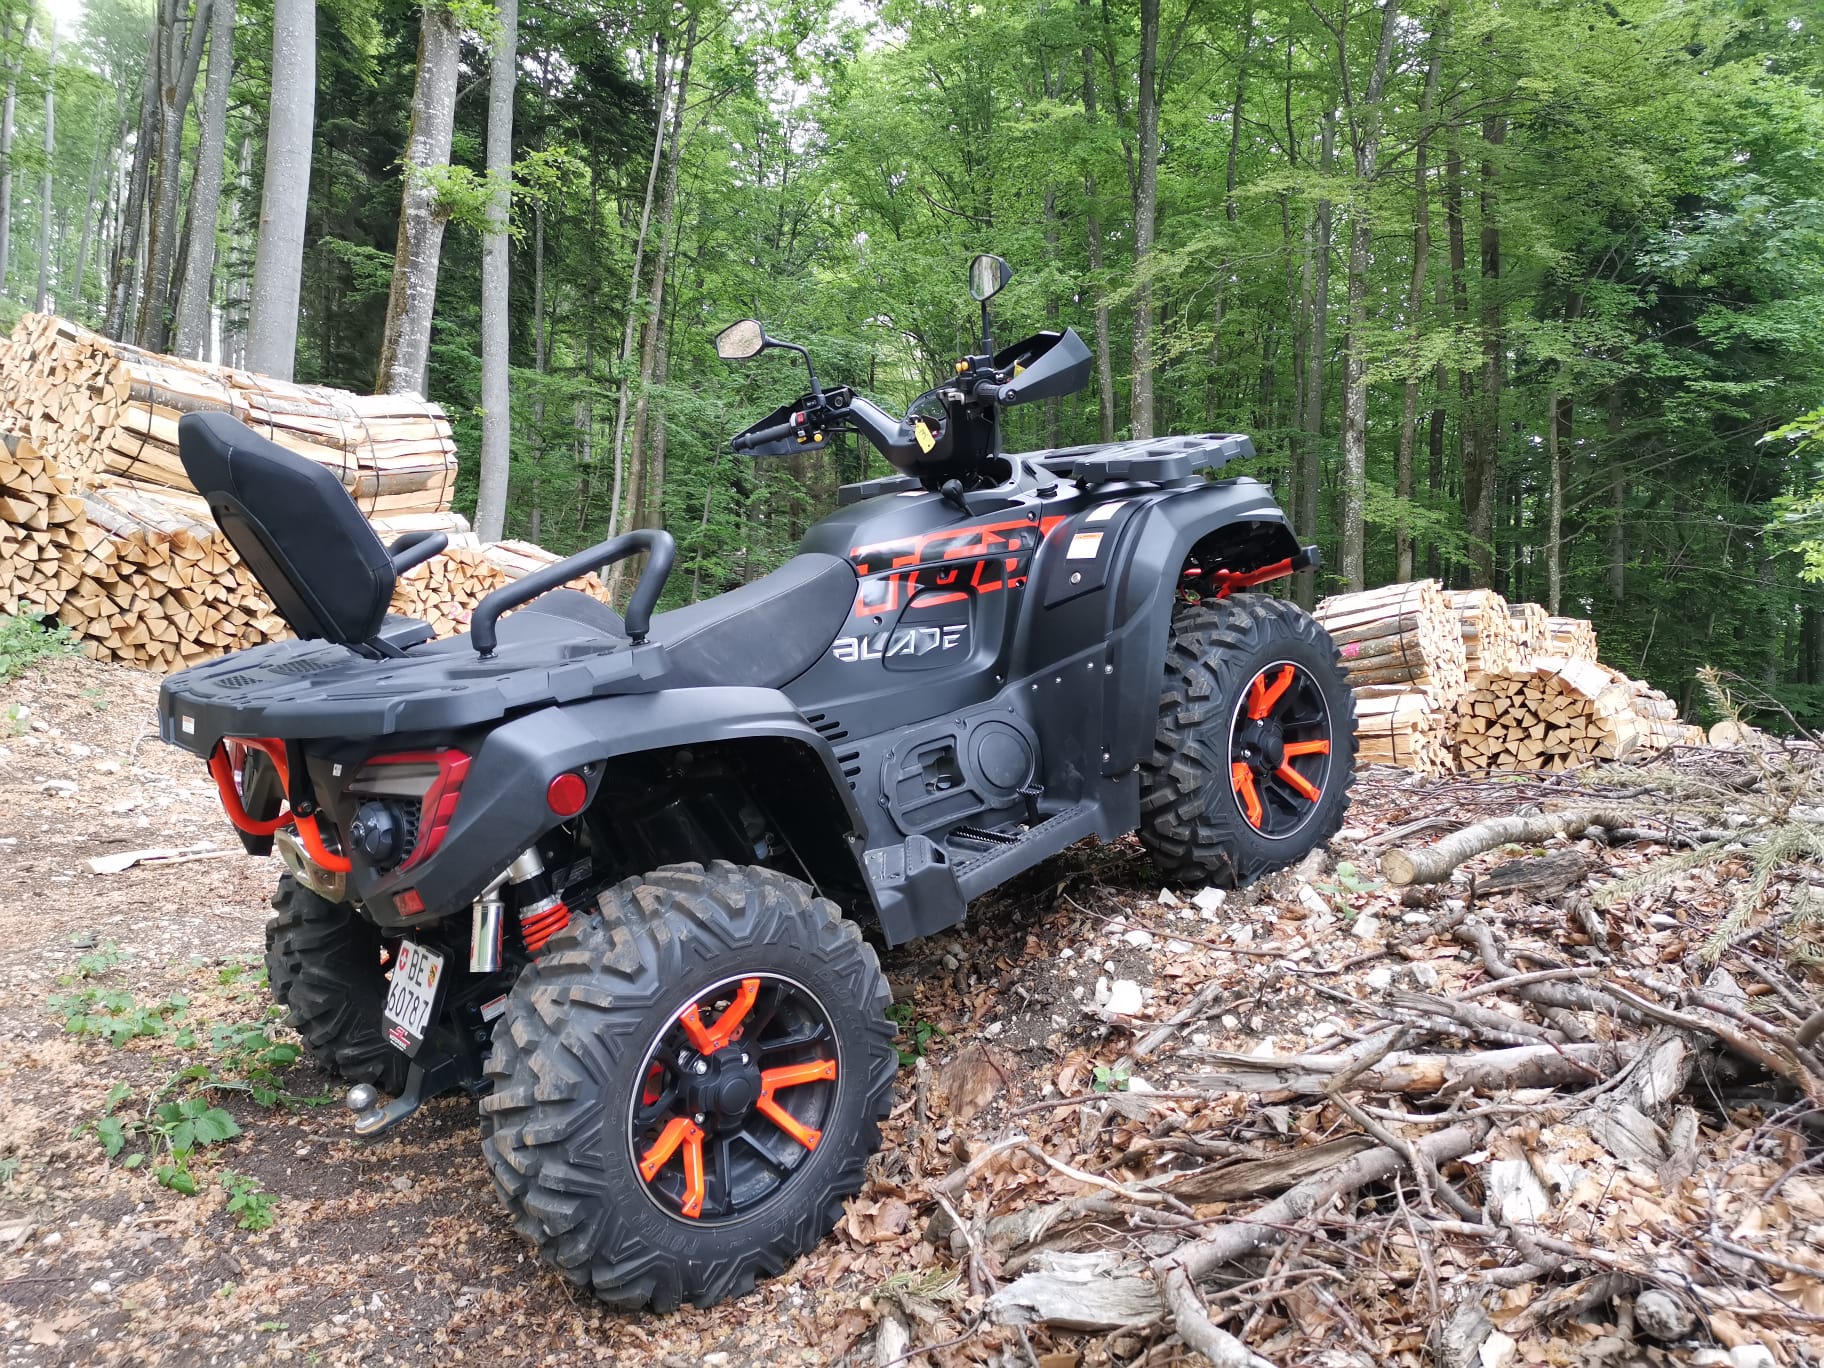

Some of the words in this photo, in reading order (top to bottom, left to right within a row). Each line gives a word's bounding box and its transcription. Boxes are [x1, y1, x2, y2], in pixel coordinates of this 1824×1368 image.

[832, 624, 968, 663] BLADE
[407, 948, 429, 988] BE
[387, 982, 430, 1032] 60787
